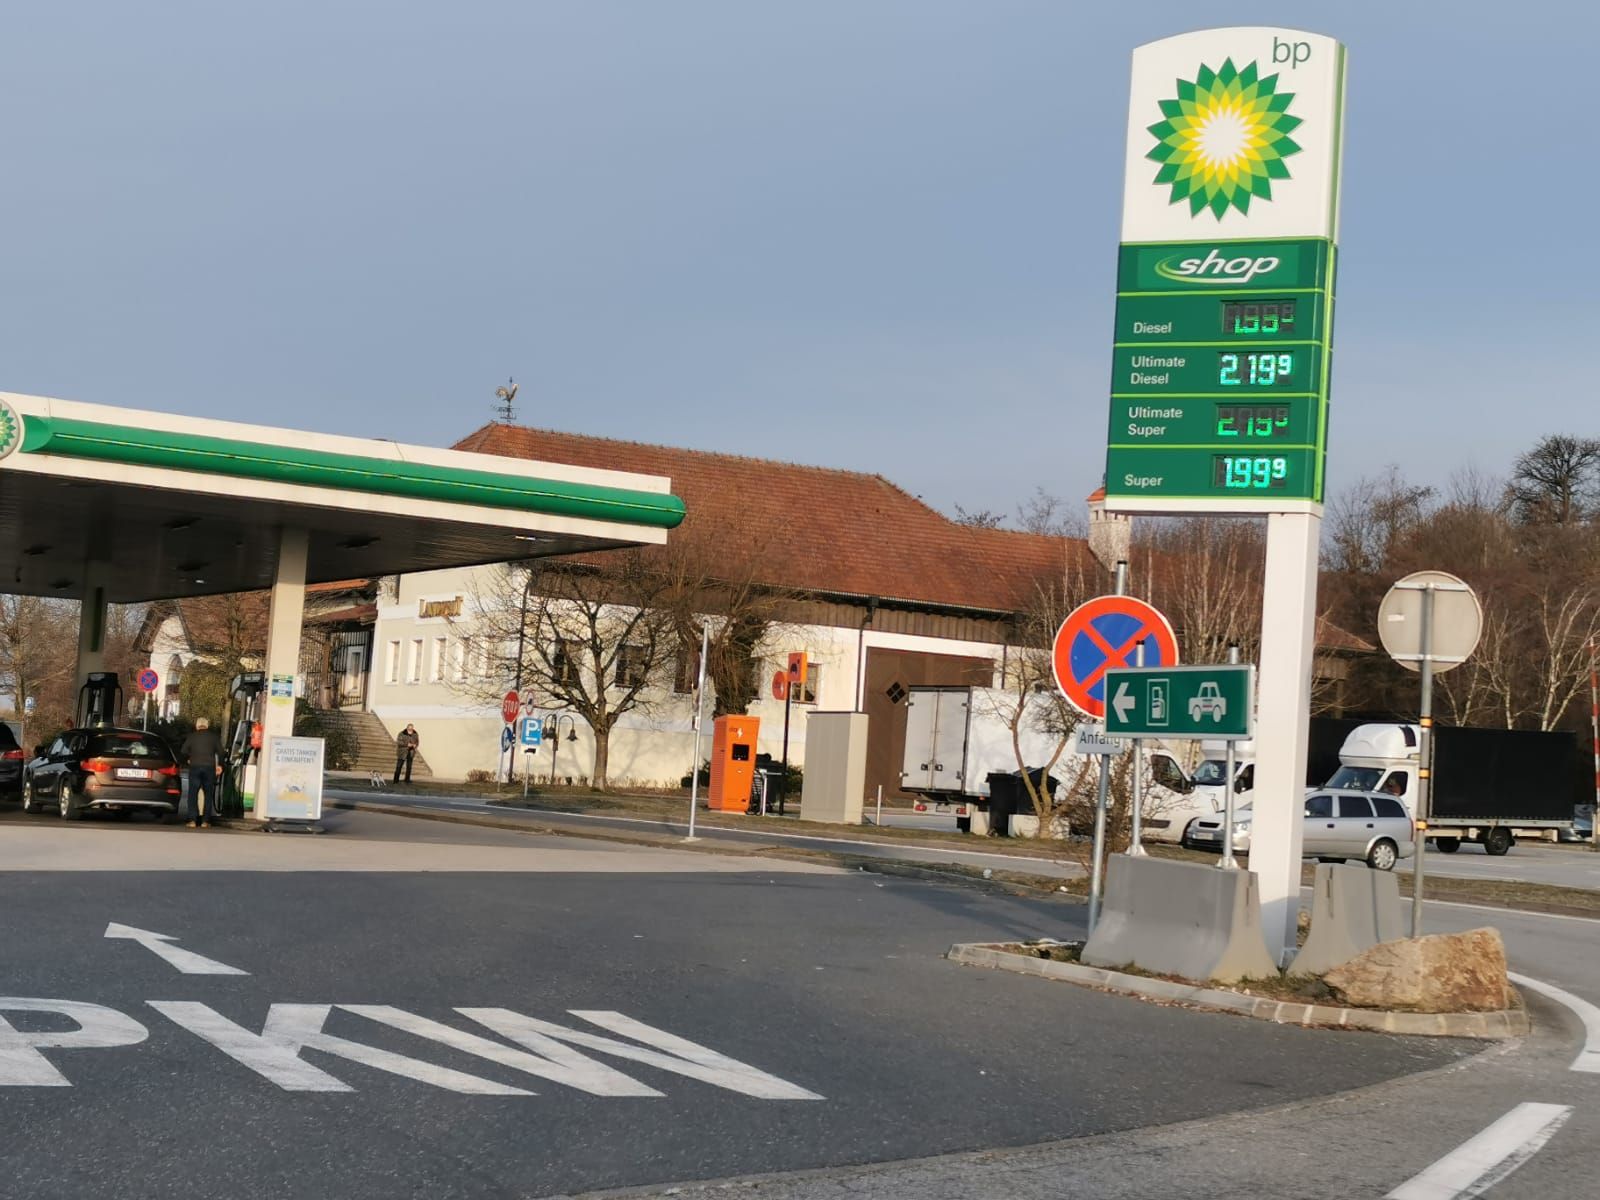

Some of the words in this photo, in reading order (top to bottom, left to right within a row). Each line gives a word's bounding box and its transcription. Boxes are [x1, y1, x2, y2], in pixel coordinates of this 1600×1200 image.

[1272, 36, 1312, 70] bp
[1176, 249, 1280, 284] shop
[1133, 322, 1172, 334] Diesel
[1131, 355, 1186, 368] Ultimate
[1130, 372, 1169, 385] Diesel
[1128, 406, 1183, 419] Ultimate
[1127, 423, 1167, 438] Super
[1124, 473, 1164, 489] Super
[503, 700, 519, 714] STOP
[525, 719, 539, 737] P
[1078, 731, 1121, 749] Anfang
